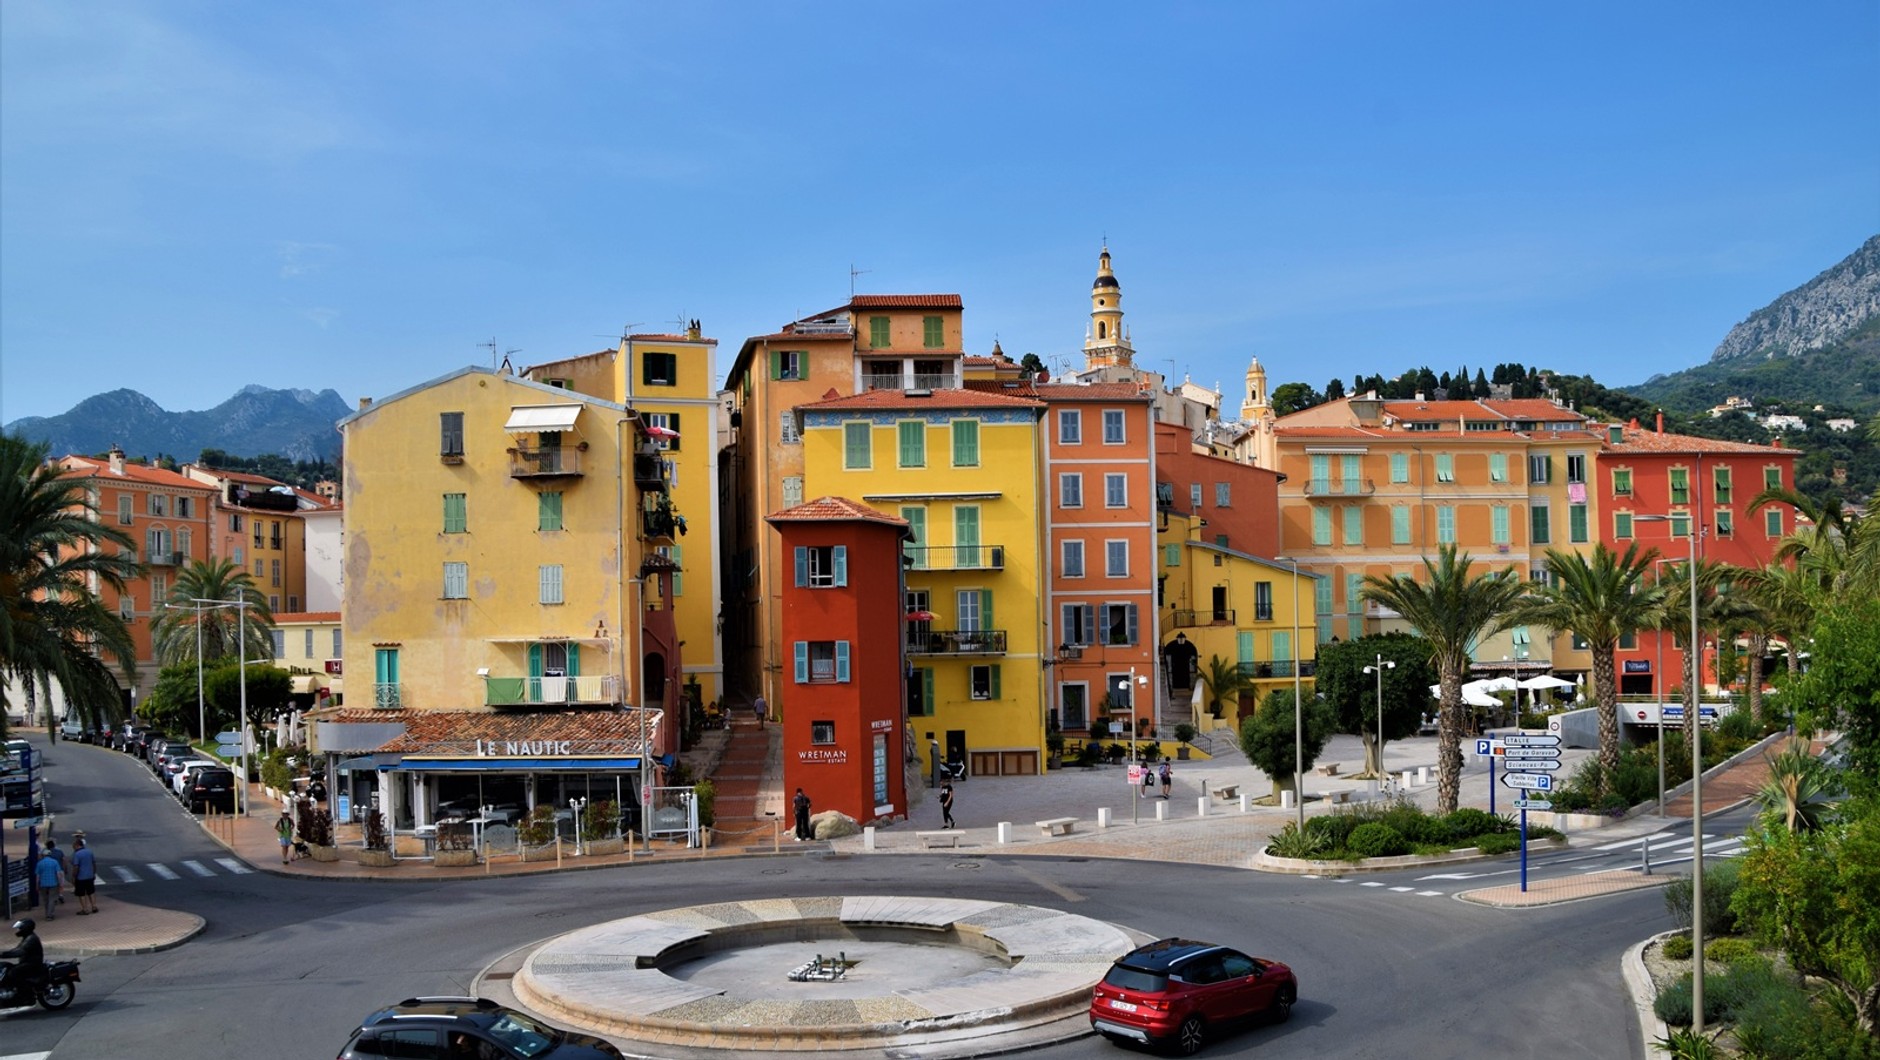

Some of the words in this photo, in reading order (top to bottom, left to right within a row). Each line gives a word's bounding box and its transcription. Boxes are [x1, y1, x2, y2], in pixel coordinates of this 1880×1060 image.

[477, 739, 496, 757] LE
[507, 740, 570, 756] NAUTIC
[1479, 741, 1488, 754] P
[799, 750, 847, 759] WRETMAN
[1539, 778, 1548, 787] P
